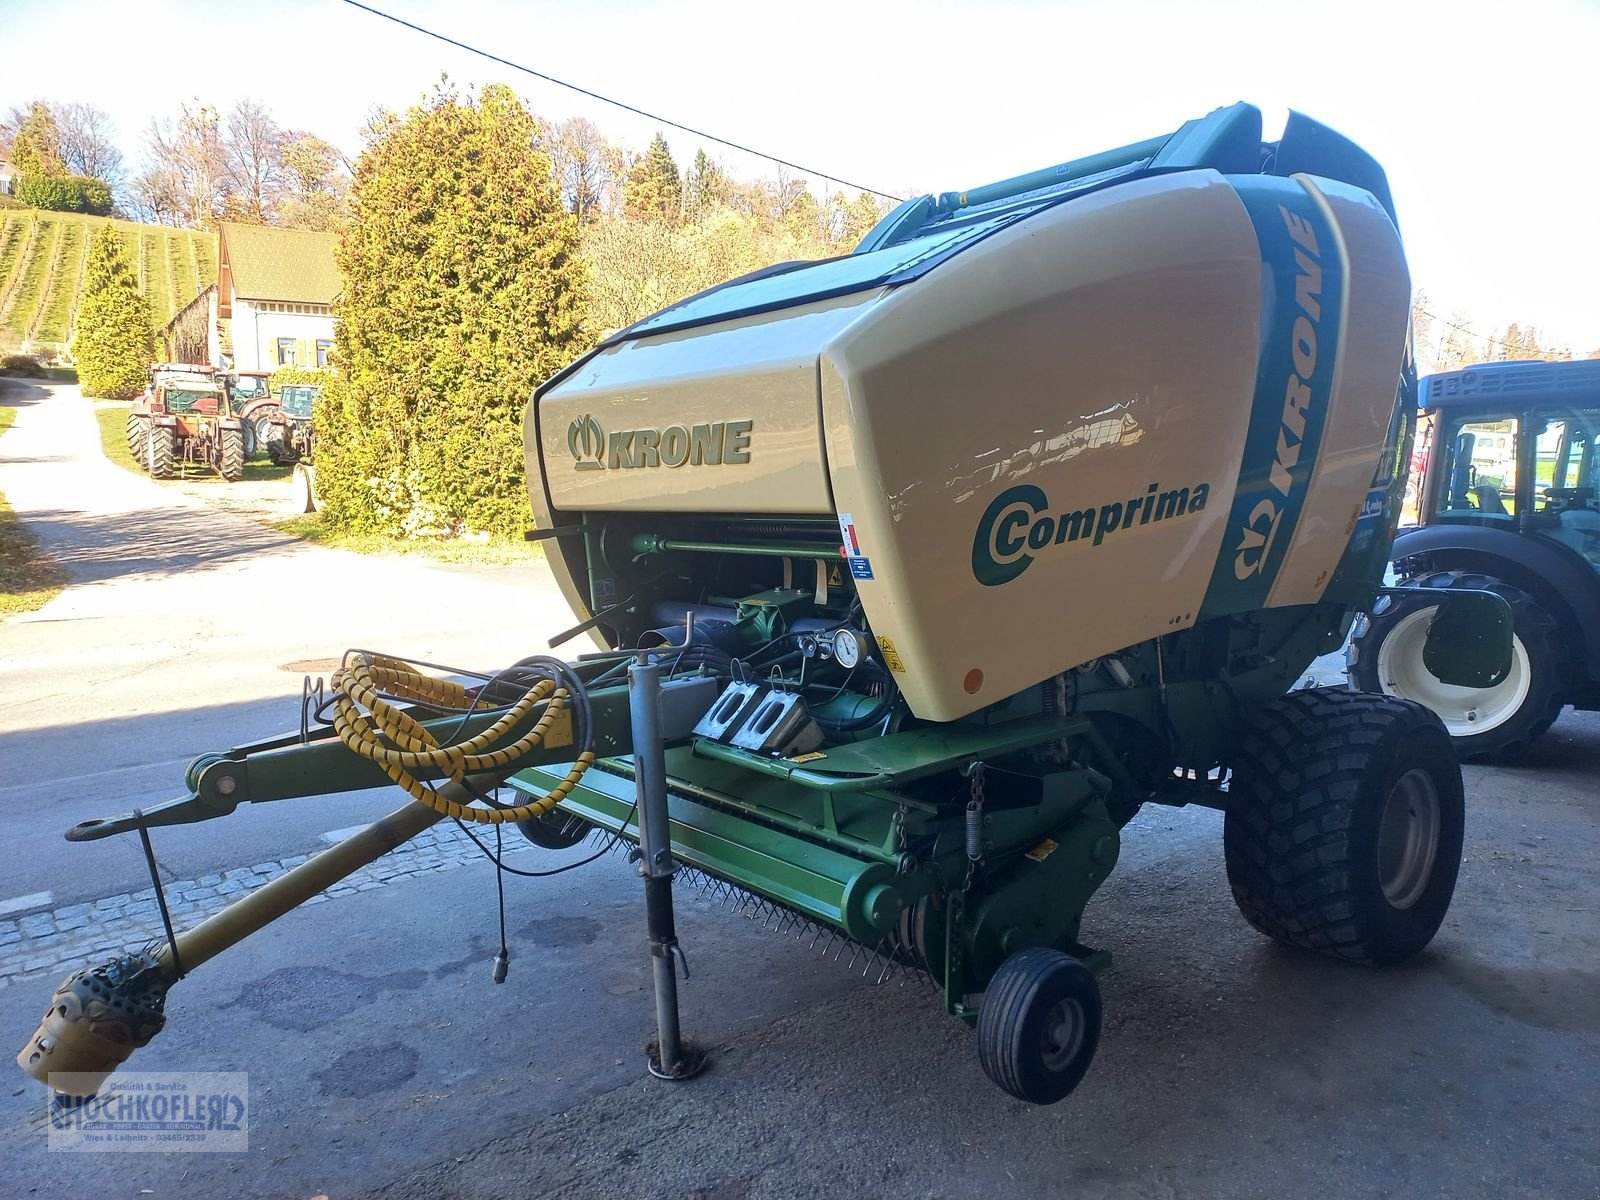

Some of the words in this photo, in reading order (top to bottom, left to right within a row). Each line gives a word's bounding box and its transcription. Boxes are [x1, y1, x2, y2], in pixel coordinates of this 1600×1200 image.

[1267, 204, 1325, 499] KRONE
[607, 418, 752, 469] KRONE
[972, 483, 1211, 587] Comprima
